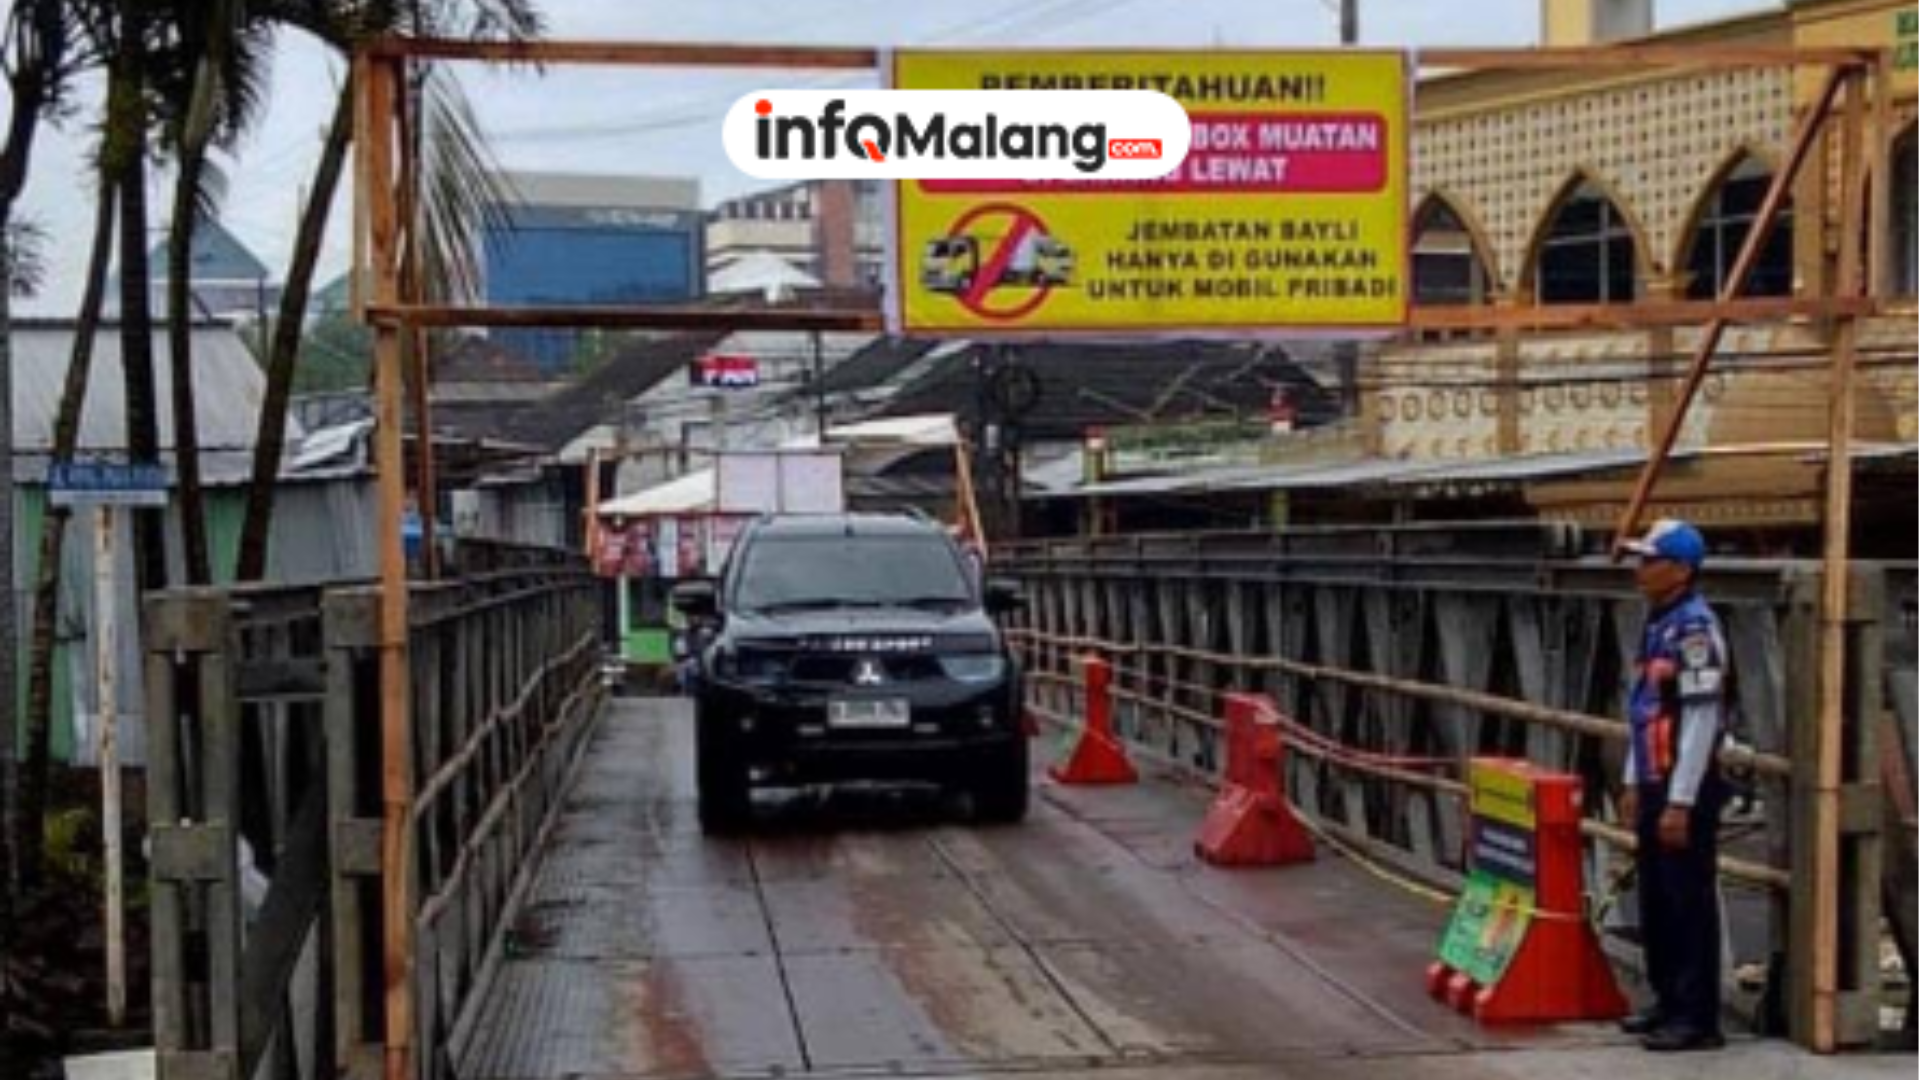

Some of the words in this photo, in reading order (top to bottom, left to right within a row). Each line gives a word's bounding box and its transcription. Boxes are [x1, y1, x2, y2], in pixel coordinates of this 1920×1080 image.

[1258, 122, 1378, 151] MUATAN
[1192, 157, 1288, 182] LEWAT
[1127, 221, 1270, 241] JEMBATAN
[1280, 221, 1359, 241] BAYLI
[1108, 249, 1198, 269] HANYA
[1207, 249, 1233, 269] DI
[1246, 249, 1377, 269] GUNAKAN
[1088, 278, 1182, 298] UNTUK
[1194, 278, 1278, 298] MOBIL
[1288, 278, 1395, 298] PRIBADI
